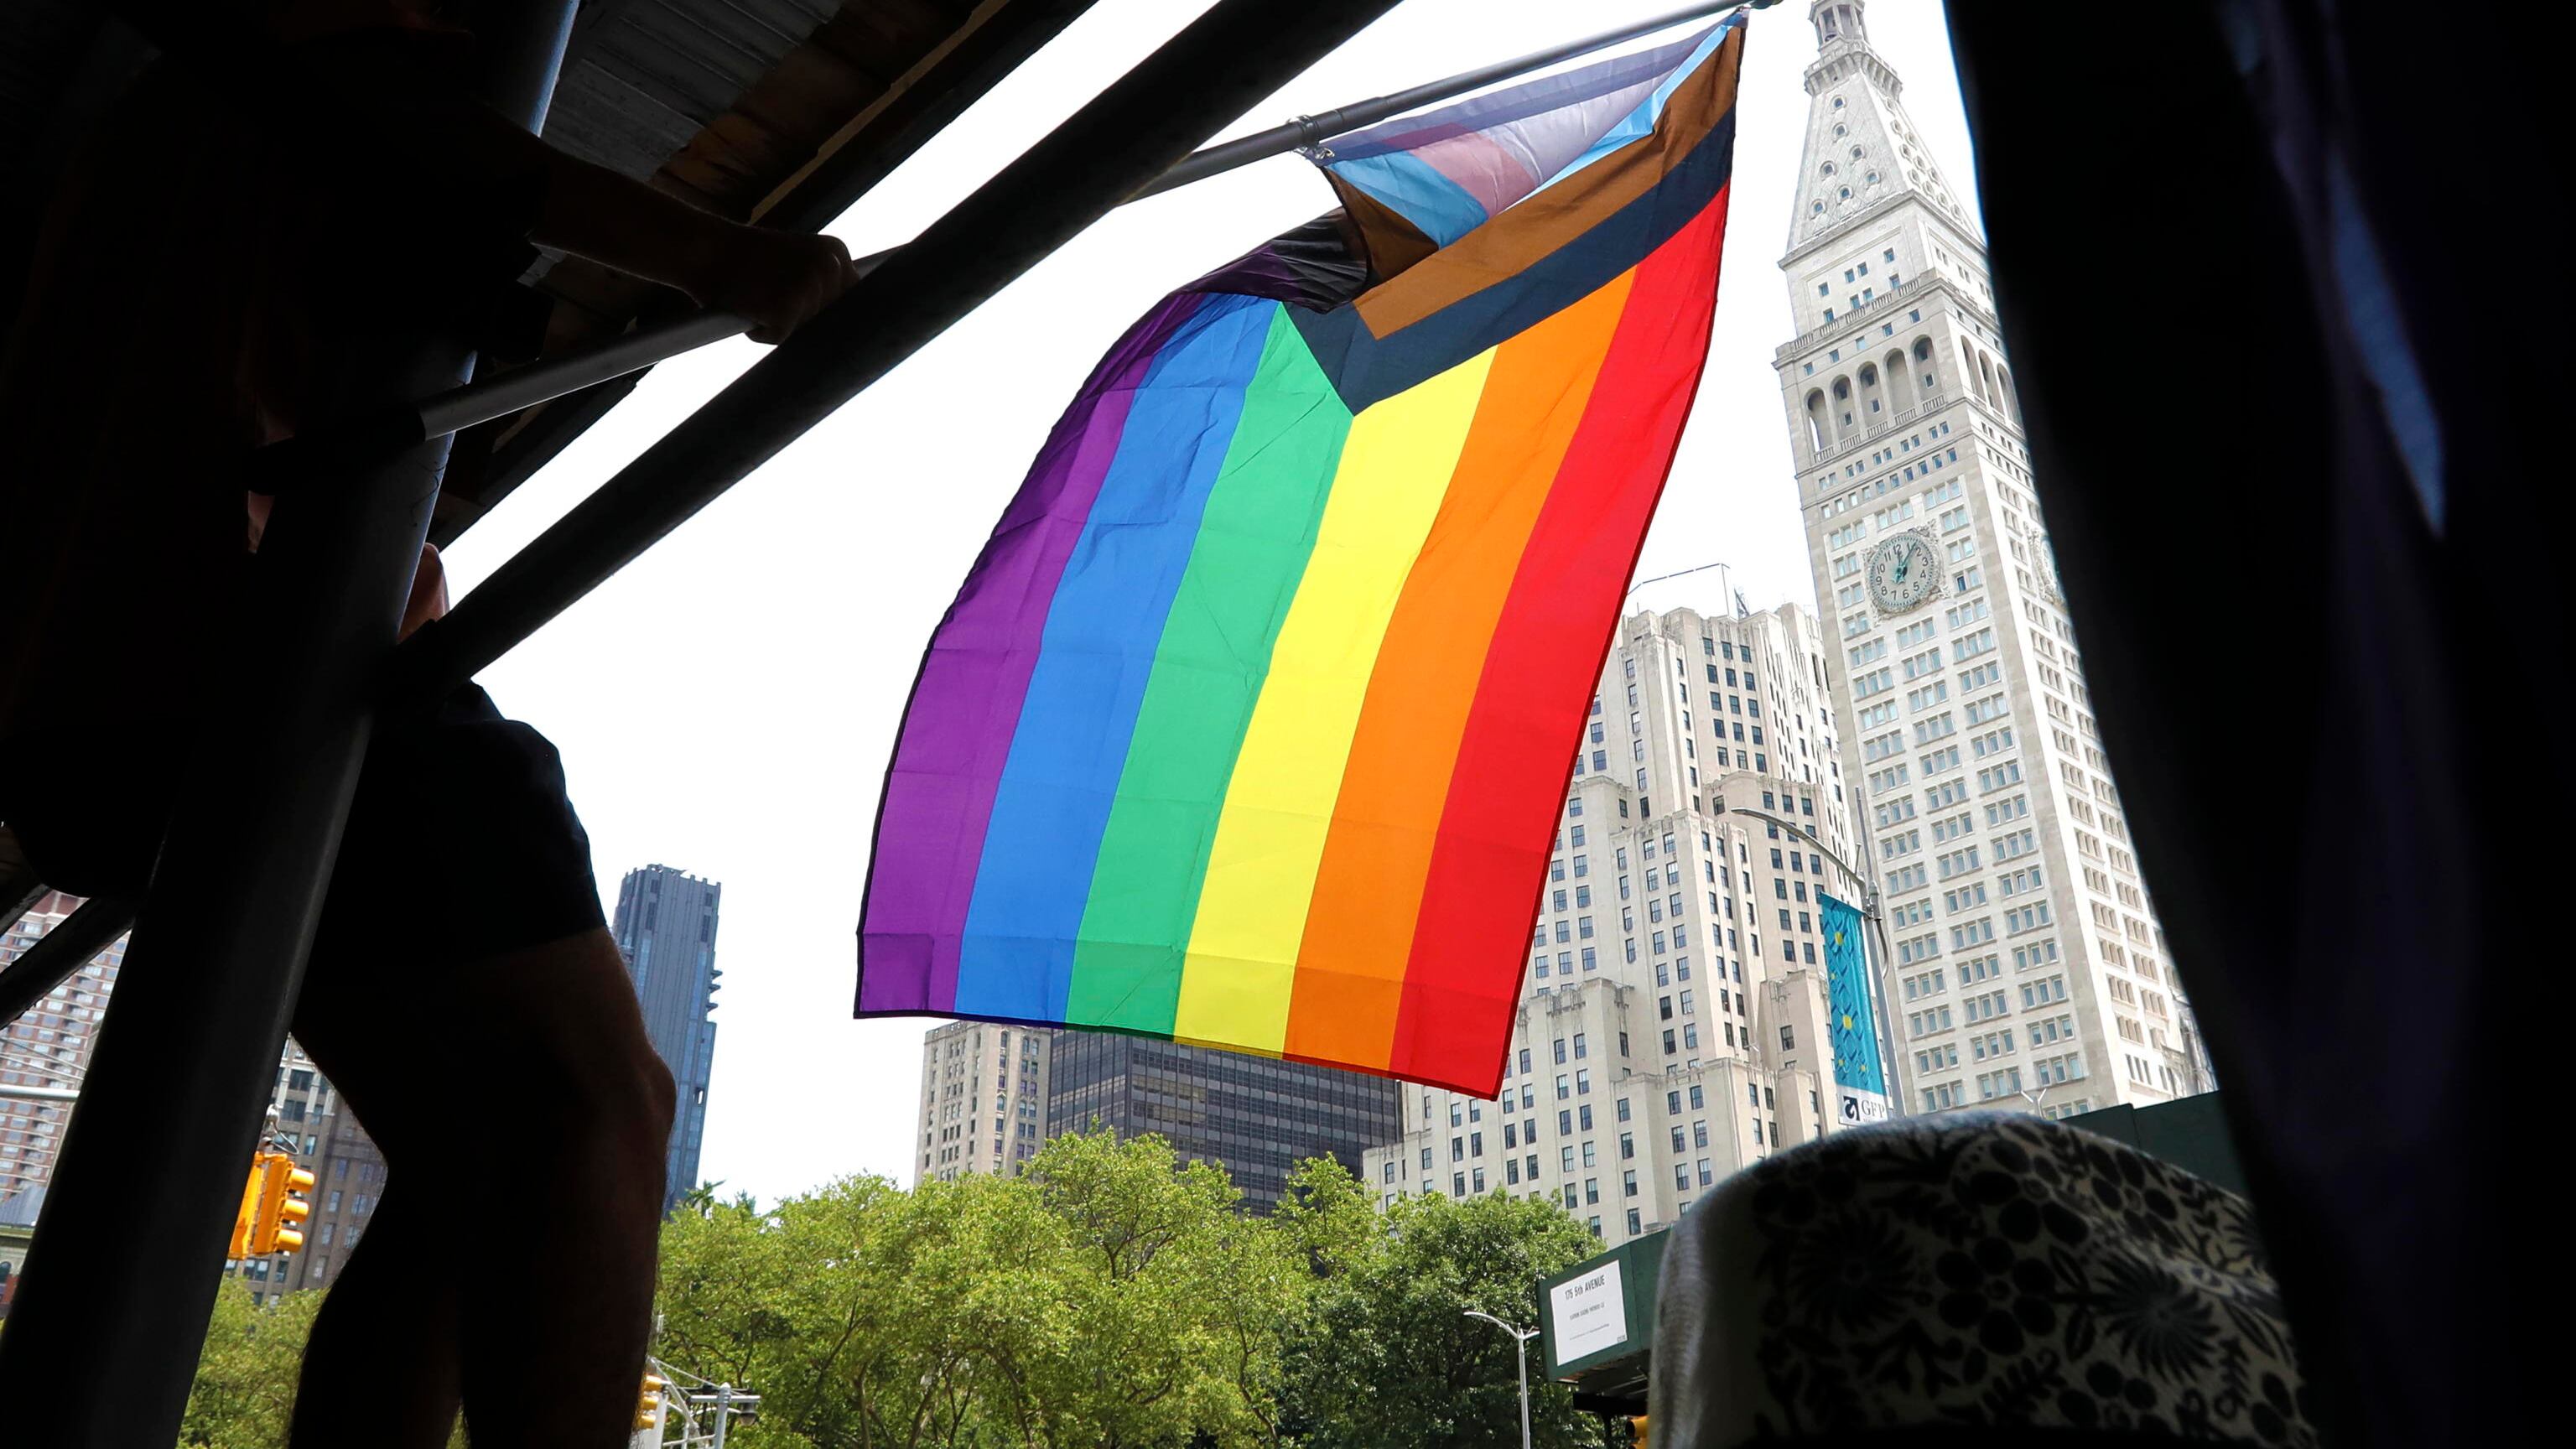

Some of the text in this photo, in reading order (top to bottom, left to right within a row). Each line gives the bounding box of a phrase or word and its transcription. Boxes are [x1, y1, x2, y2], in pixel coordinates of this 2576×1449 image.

[1893, 543, 1901, 555] 12
[1915, 547, 1922, 557] 2
[1884, 551, 1892, 562] 11
[1922, 557, 1929, 566] 3
[1877, 564, 1885, 574] 10
[1920, 569, 1926, 579] 4
[1876, 576, 1883, 585] 9
[1881, 586, 1888, 595] 8
[1913, 581, 1919, 591] 5
[1891, 589, 1897, 600] 7
[1903, 589, 1909, 599] 6
[1862, 1099, 1885, 1118] GFP
[1565, 1275, 1605, 1300] 175 5th AVENUE
